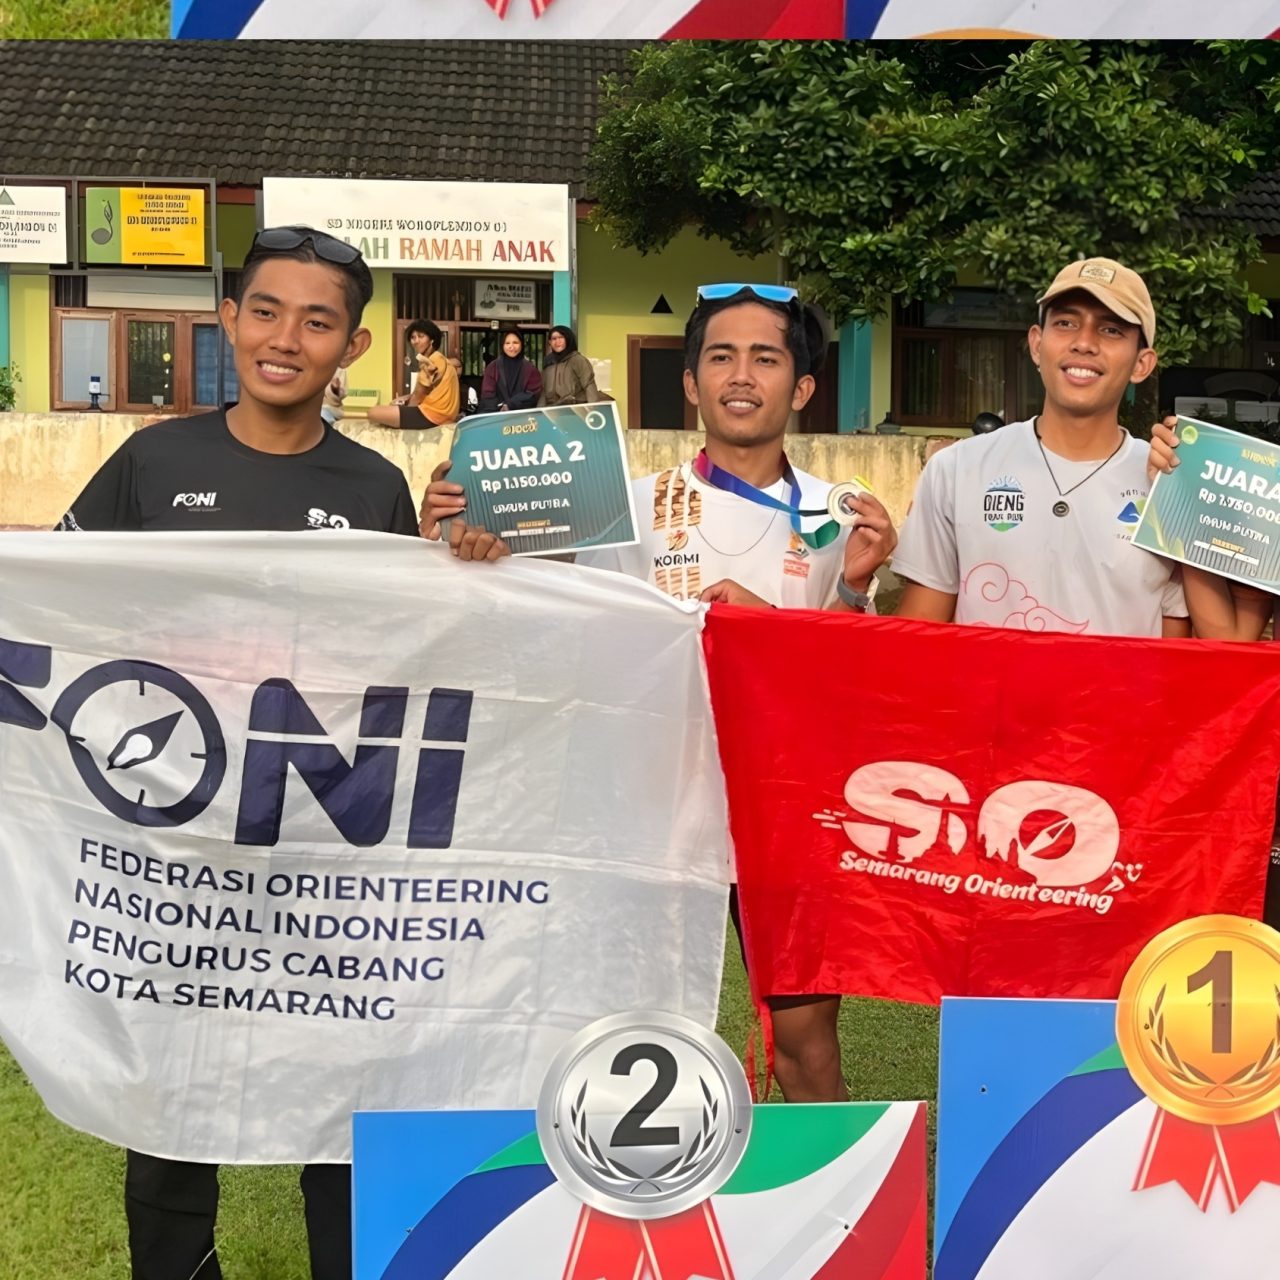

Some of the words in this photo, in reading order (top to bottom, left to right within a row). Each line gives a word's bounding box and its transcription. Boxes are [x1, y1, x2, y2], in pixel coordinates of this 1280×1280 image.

[400, 237, 482, 261] RAMAH
[492, 240, 555, 262] ANAK
[470, 443, 561, 472] JUARA
[566, 440, 585, 462] 2
[481, 479, 501, 493] Rp
[172, 492, 217, 507] FONI
[80, 837, 254, 895] FEDERASI
[266, 873, 549, 905] ORIENTEERING
[839, 850, 962, 894] Semarang
[964, 874, 1114, 915] Orienteering
[75, 878, 262, 935] NASIONAL
[274, 911, 485, 942] INDONESIA
[68, 919, 271, 973] PENGURUS
[283, 952, 444, 982] CABANG
[64, 959, 160, 1004] KOTA
[172, 982, 395, 1020] SEMARANG
[1187, 950, 1232, 1053] 1
[610, 1043, 679, 1147] 2
